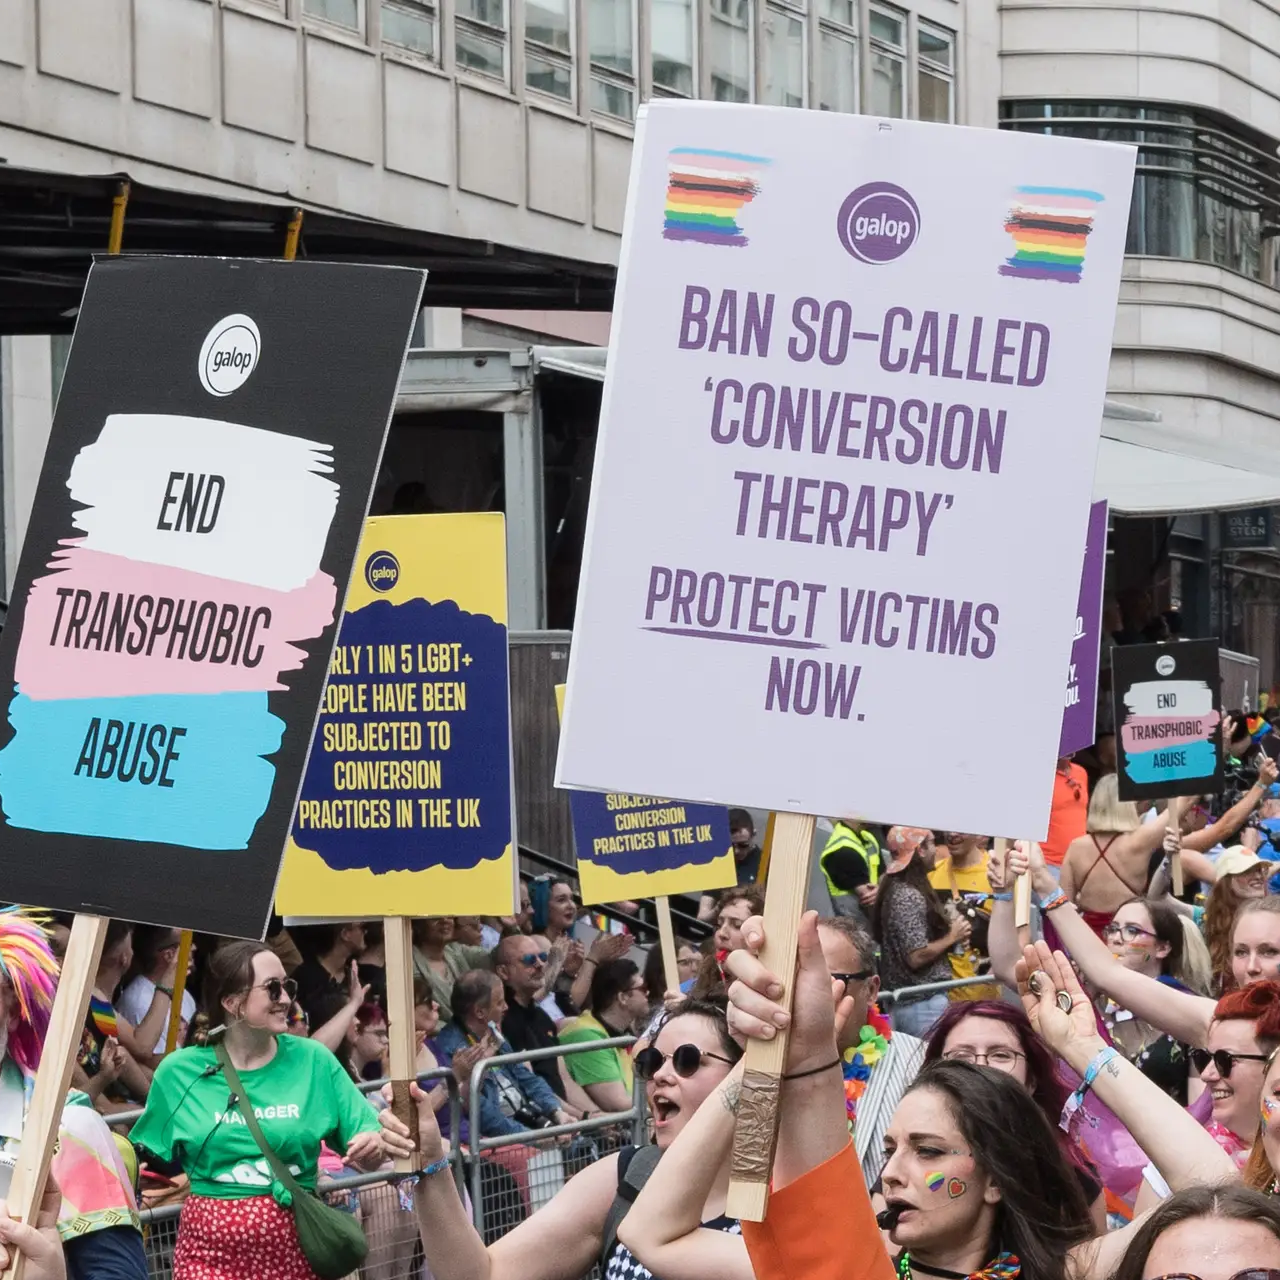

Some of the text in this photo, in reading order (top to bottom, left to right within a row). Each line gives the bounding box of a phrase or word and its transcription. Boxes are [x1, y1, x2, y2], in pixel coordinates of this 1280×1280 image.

[854, 210, 911, 245] galop
[678, 284, 1051, 388] BAN SO-CALLED
[211, 340, 253, 376] galop
[155, 470, 226, 535] END
[1229, 526, 1266, 537] STEEN
[372, 566, 397, 581] galop
[48, 586, 272, 669] TRANSPHOBIC
[645, 566, 1000, 660] PROTECT VICTIMS
[329, 643, 473, 675] RLY 1 IN 5 LGBT+
[320, 682, 466, 714] EOPLE HAVE BEEN
[763, 655, 866, 723] NOW.
[1065, 685, 1080, 708] OU.
[1157, 693, 1177, 709] END
[323, 721, 451, 753] SUBJECTED TO
[1130, 720, 1203, 741] TRANSPHOBIC
[73, 716, 188, 789] ABUSE
[1153, 751, 1187, 768] ABUSE
[333, 760, 441, 791] CONVERSION
[299, 798, 481, 830] PRACTICES IN THE UK
[614, 807, 687, 832] CONVERSION
[593, 824, 713, 855] PRACTICES IN THE UK
